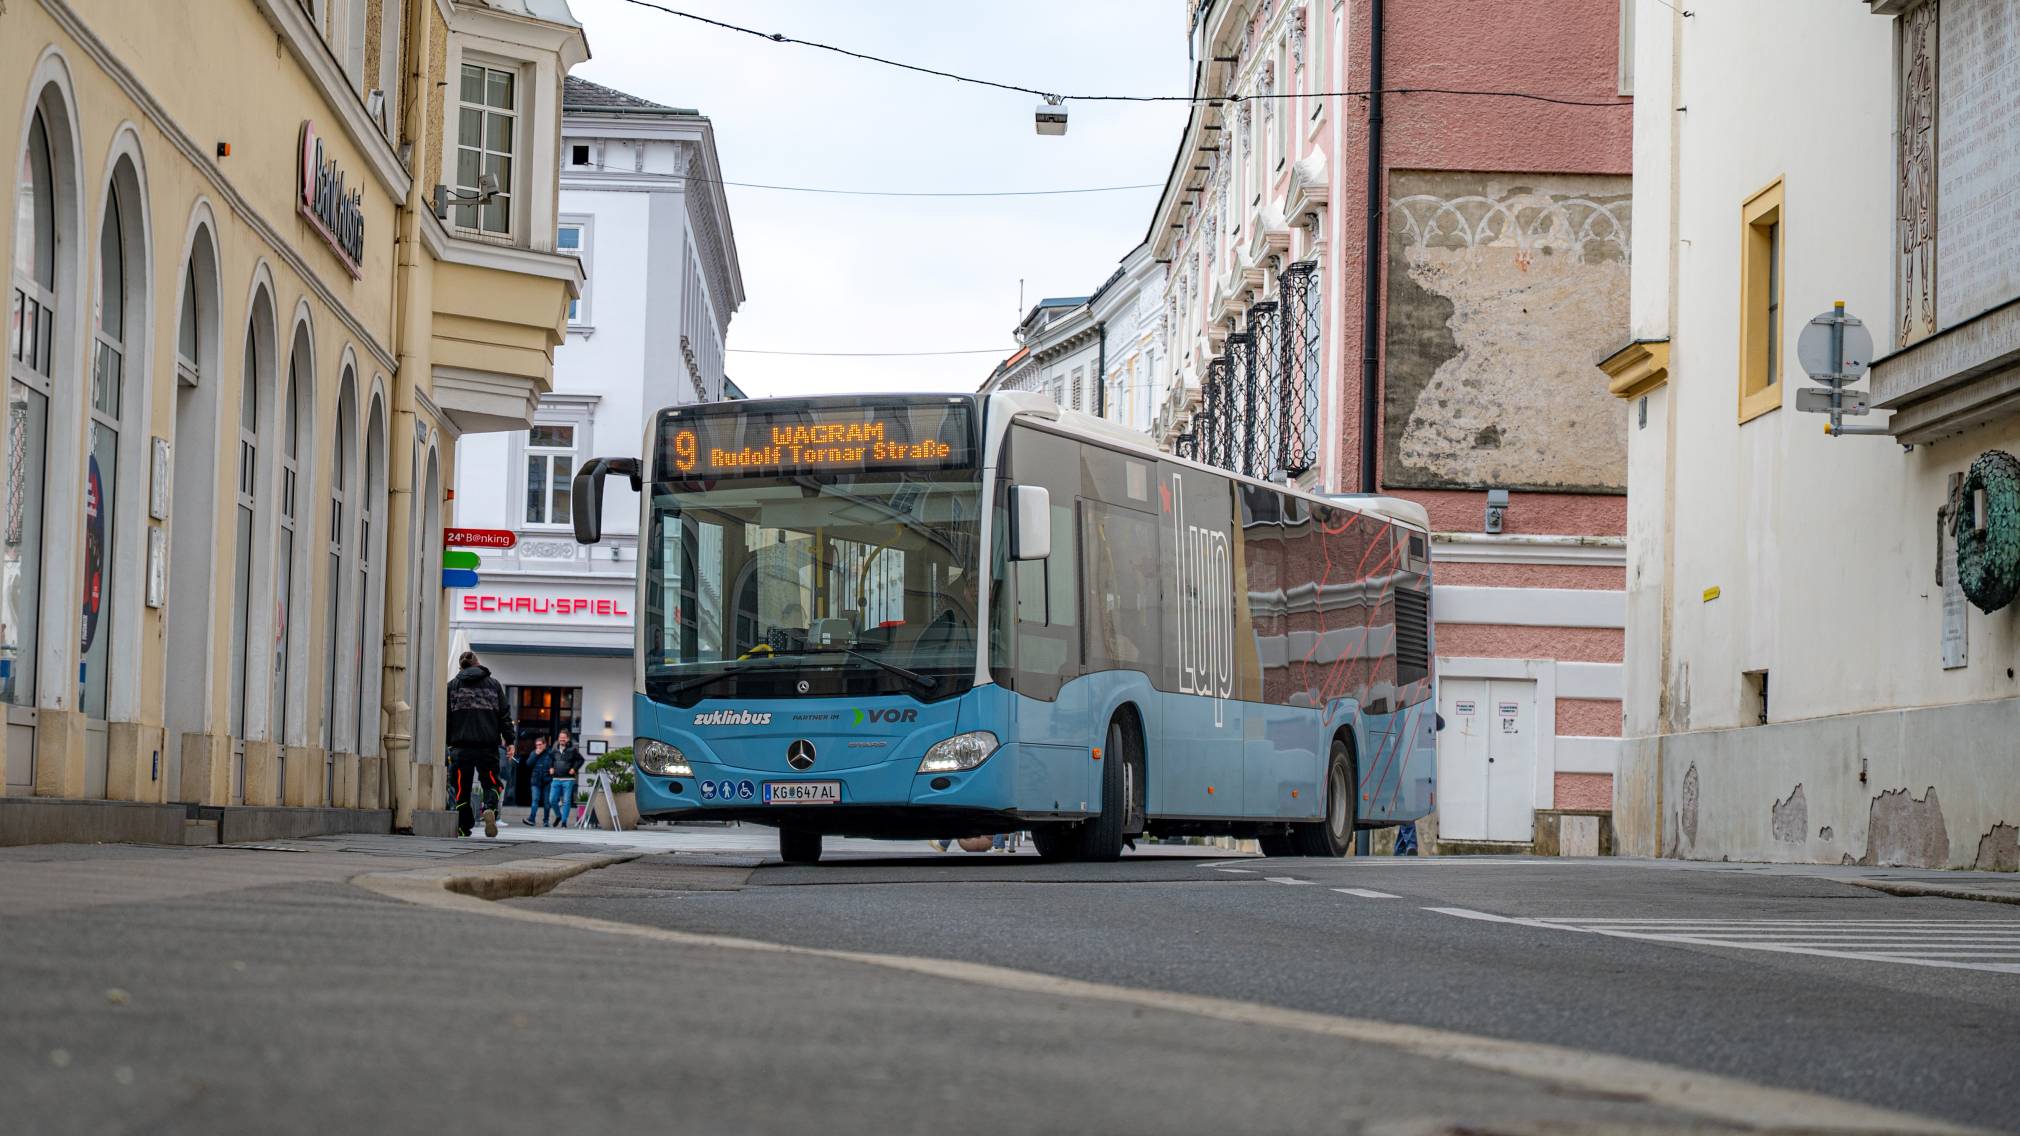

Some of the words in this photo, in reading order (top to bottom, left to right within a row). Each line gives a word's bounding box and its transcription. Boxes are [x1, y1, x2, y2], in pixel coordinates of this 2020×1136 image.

[772, 423, 884, 445] WAGRAM
[674, 431, 697, 471] 9
[711, 446, 781, 468] Rudolf
[788, 446, 864, 464] Tornar
[873, 440, 949, 461] Straße
[466, 533, 510, 545] B@nking
[693, 709, 772, 726] zuklinbus
[868, 708, 918, 723] VOR
[773, 786, 788, 799] KG
[796, 786, 818, 799] 647
[821, 785, 836, 799] AL
